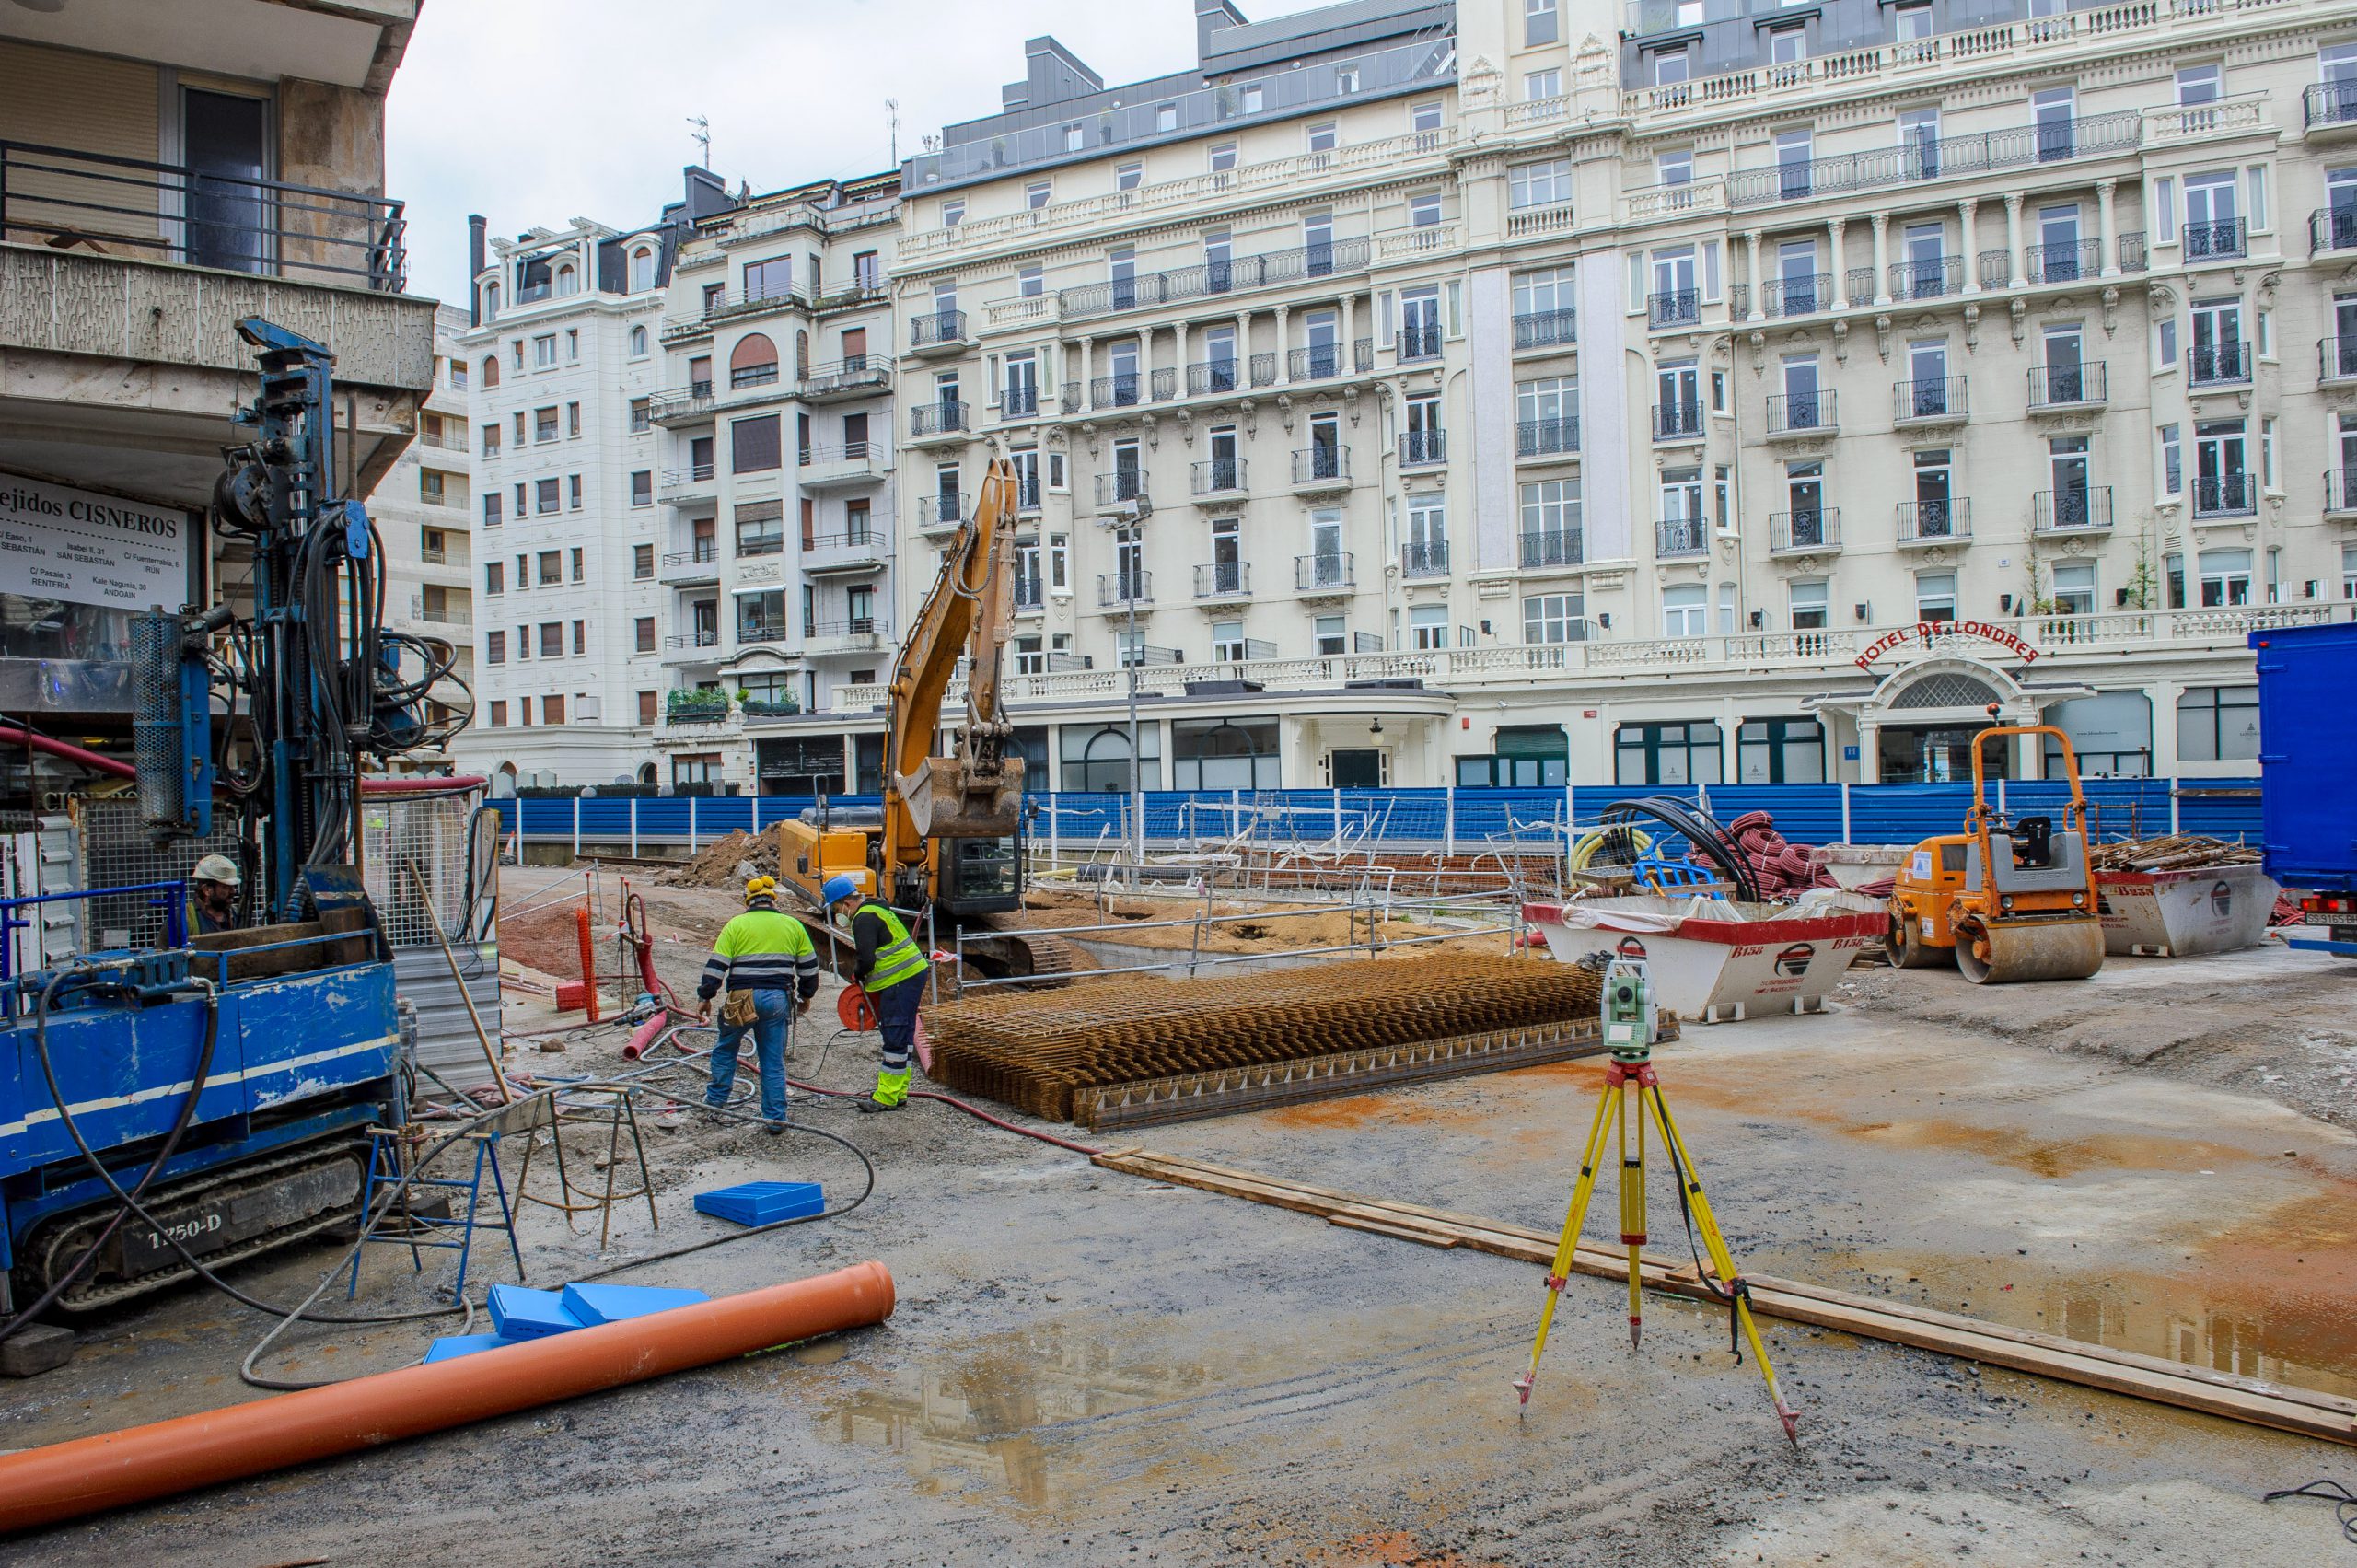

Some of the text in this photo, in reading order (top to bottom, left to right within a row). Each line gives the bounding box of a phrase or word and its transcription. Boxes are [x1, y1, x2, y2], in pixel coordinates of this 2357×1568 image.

[69, 500, 177, 539] CISNEROS
[56, 551, 73, 560] SAN
[92, 575, 108, 586] Kale
[138, 583, 147, 591] 30
[104, 588, 136, 599] ANDOAIN
[1854, 620, 2039, 669] HOTEL DE LONDRES
[1831, 937, 1864, 950] B158
[1731, 946, 1765, 958] B158
